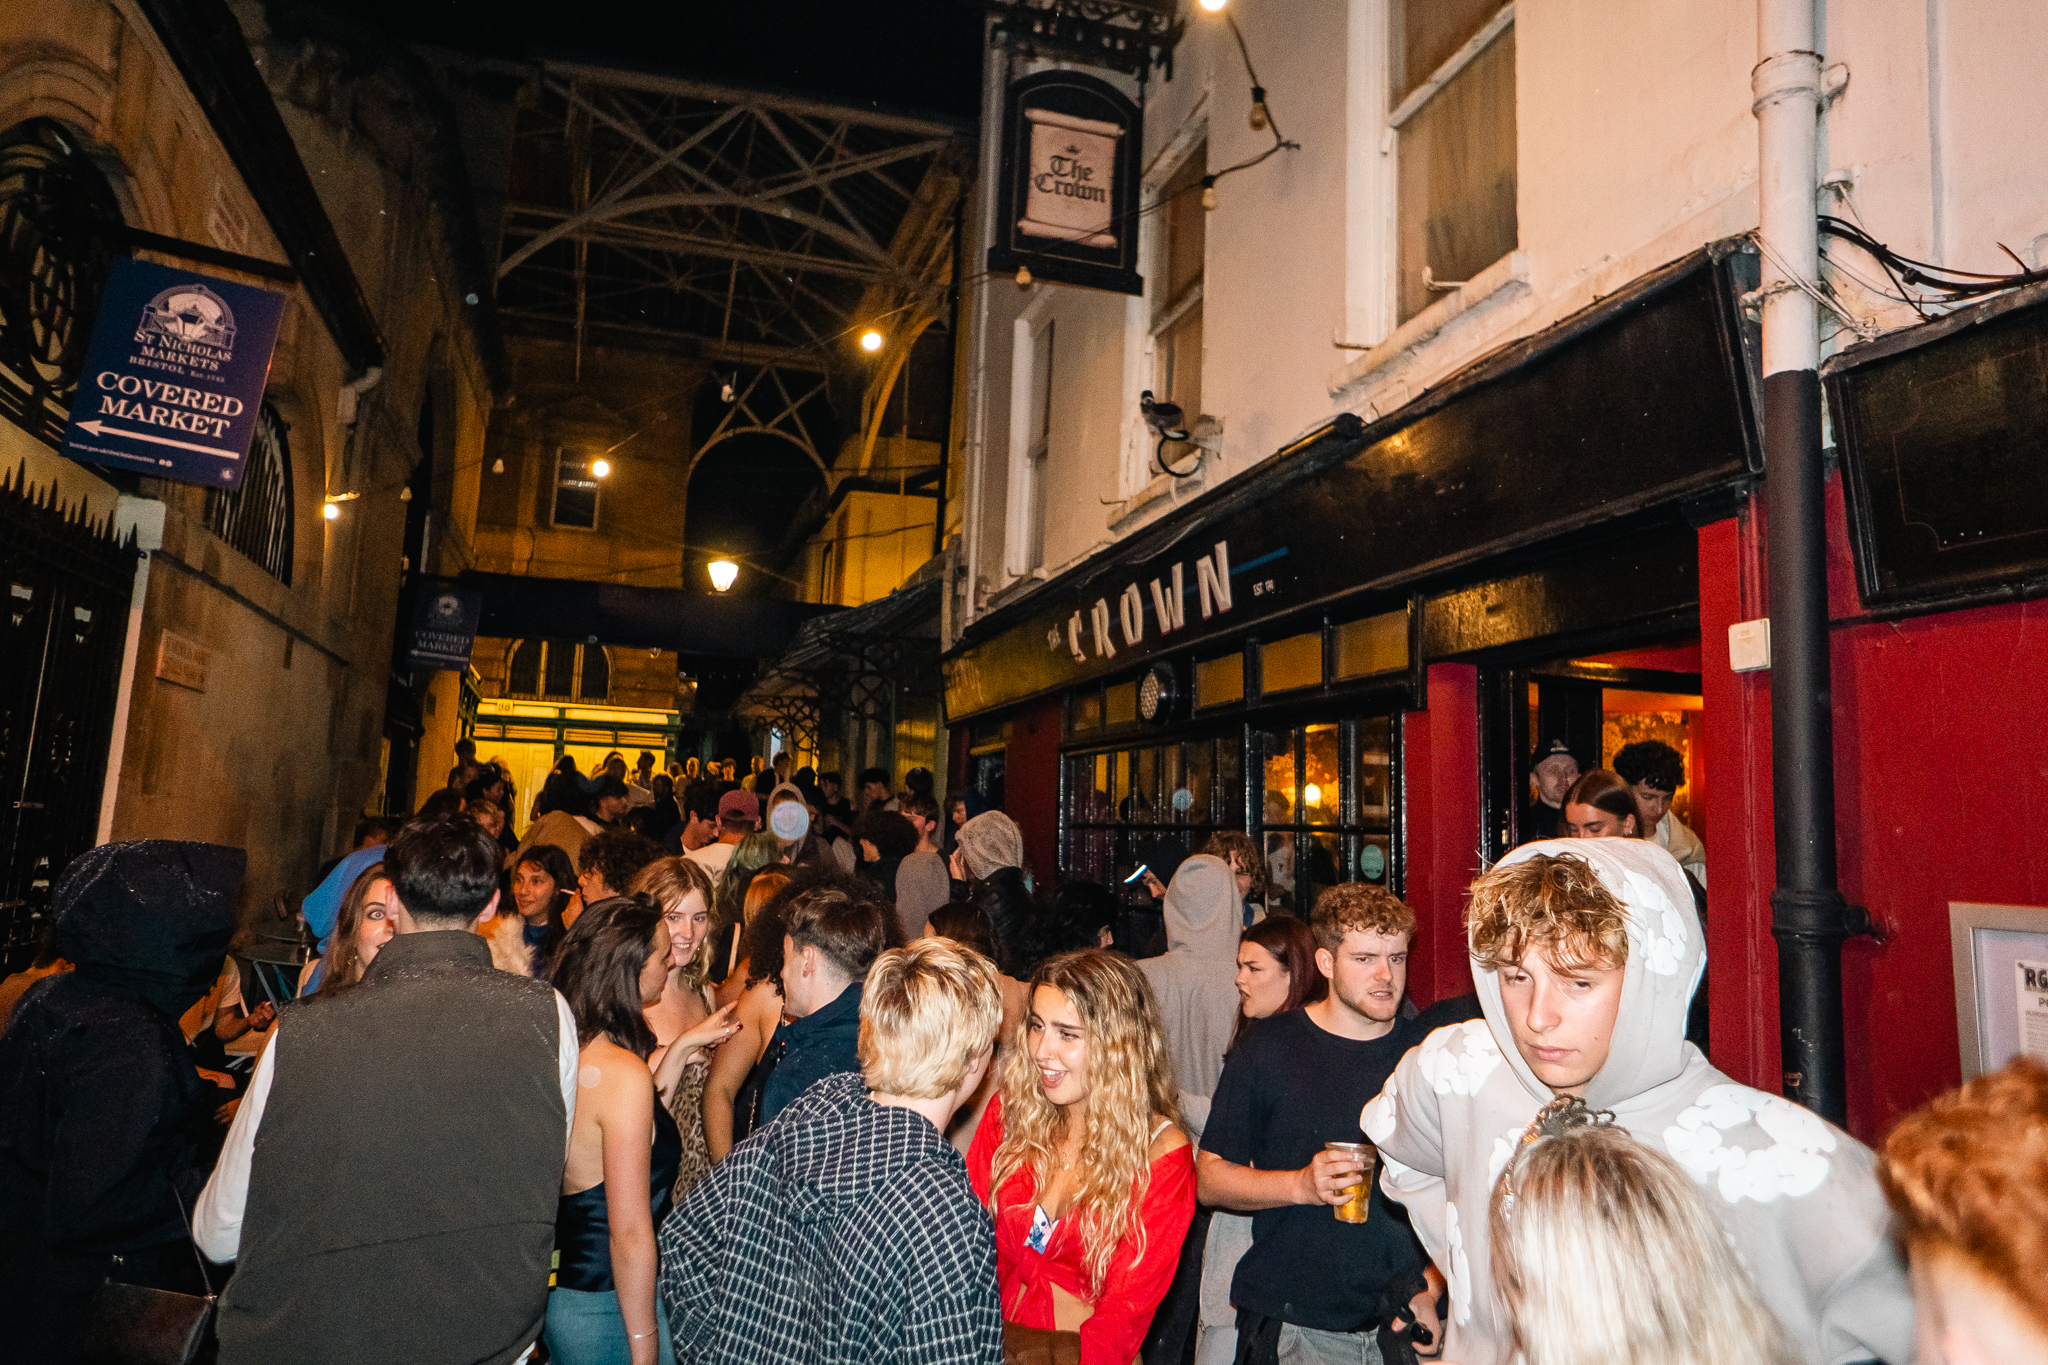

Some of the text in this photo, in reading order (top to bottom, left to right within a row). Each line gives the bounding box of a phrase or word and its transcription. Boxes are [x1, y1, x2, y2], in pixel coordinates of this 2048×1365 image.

[1051, 154, 1094, 182] The
[1034, 172, 1106, 203] Crown
[129, 355, 185, 376] BRISTOL
[140, 345, 220, 371] MARKETS
[97, 371, 243, 417] COVERED
[98, 395, 230, 438] MARKET
[1068, 540, 1232, 664] CROWN
[414, 630, 470, 645] COVERED
[418, 640, 465, 654] MARKET
